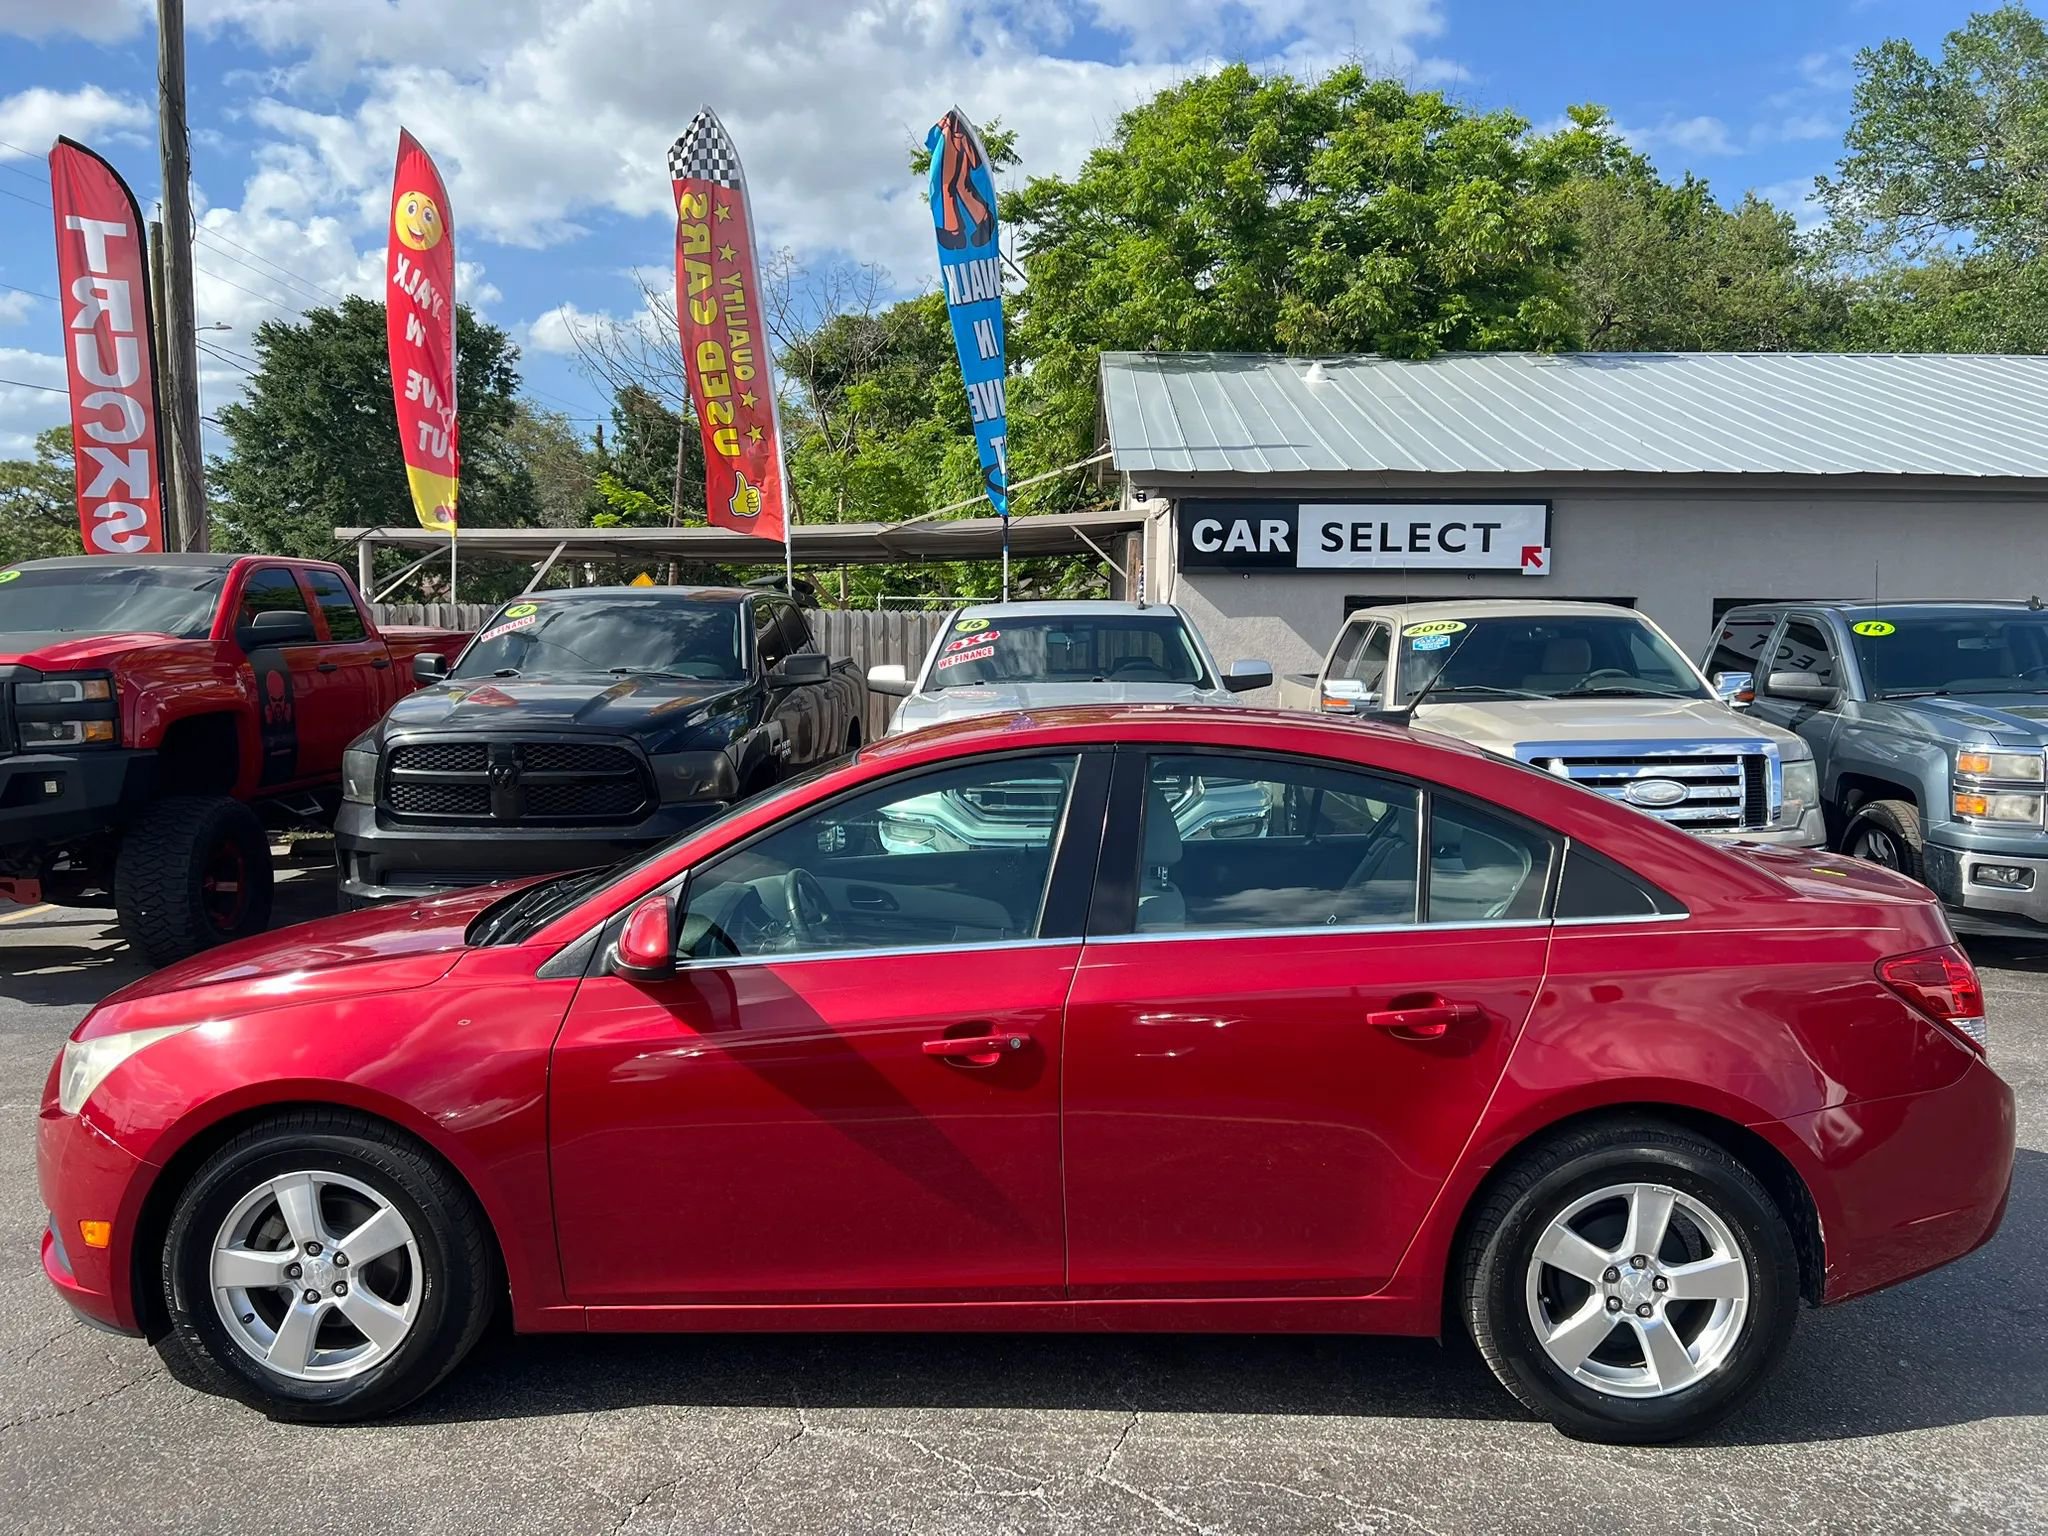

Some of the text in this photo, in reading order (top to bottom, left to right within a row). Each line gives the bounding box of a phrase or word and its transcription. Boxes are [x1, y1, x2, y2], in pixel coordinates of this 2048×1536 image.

[1191, 518, 1502, 553] CAR SELECT
[482, 617, 534, 640] WE FINANCE
[962, 620, 983, 630] 16
[1408, 623, 1459, 635] 2009
[1863, 623, 1885, 632] 14
[939, 646, 993, 668] WE FINANCE
